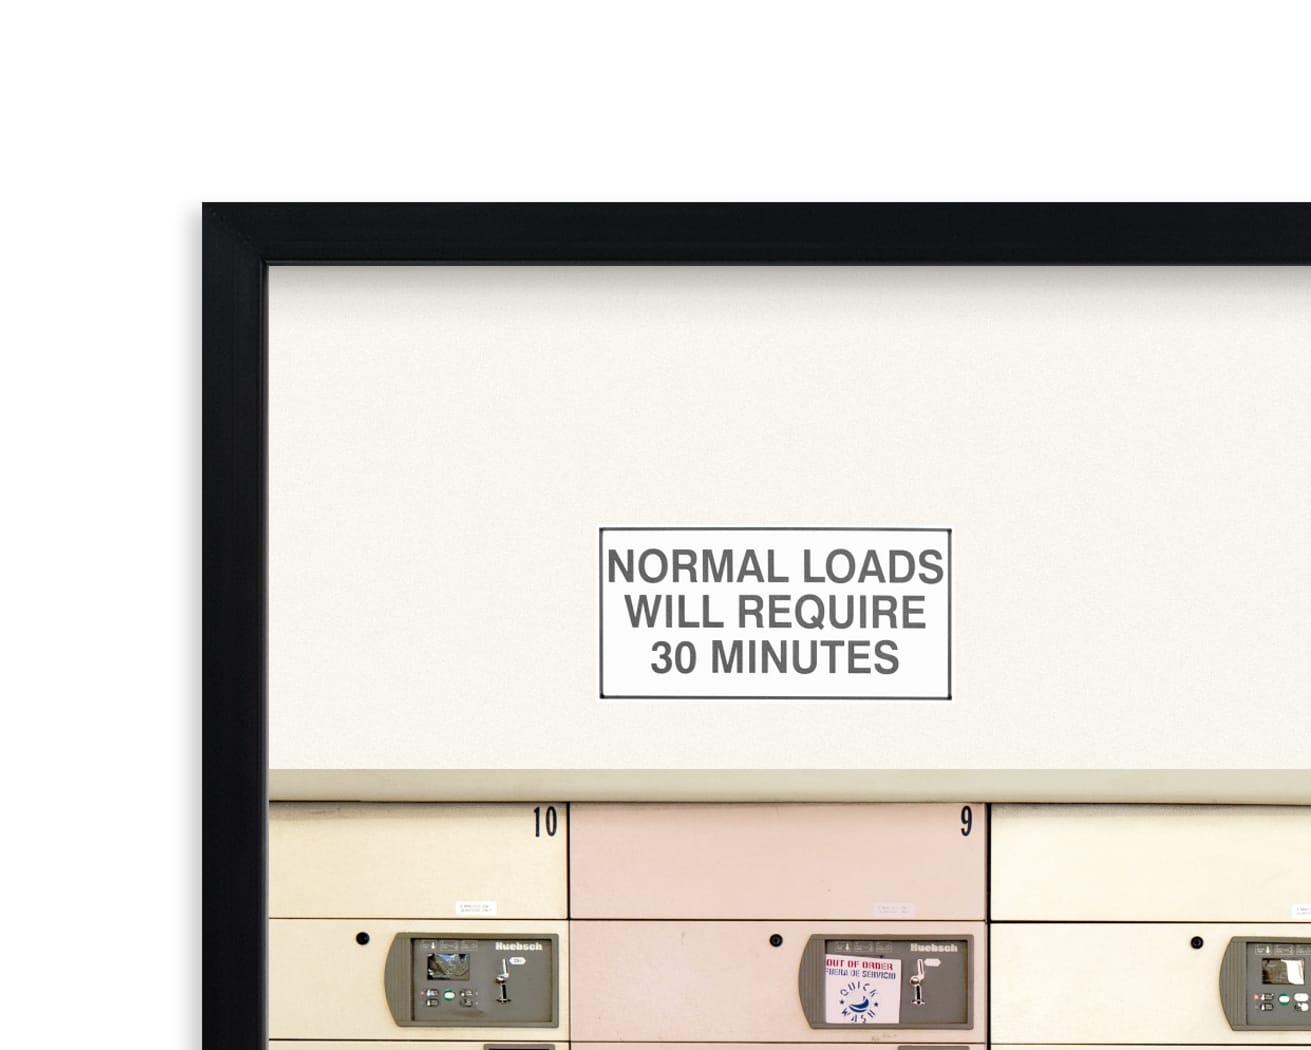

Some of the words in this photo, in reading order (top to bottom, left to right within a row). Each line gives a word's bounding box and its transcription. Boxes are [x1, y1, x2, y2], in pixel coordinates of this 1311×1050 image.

[607, 548, 790, 584] NORMAL
[803, 548, 945, 585] LOADS
[623, 594, 725, 629] WILL
[738, 593, 927, 630] REQUIRE
[650, 640, 698, 675] 30
[711, 639, 900, 675] MINUTES
[533, 805, 558, 838] 10
[960, 805, 974, 837] 9
[495, 941, 543, 952] Huebsch
[910, 943, 958, 953] Huebsch
[826, 958, 845, 968] OUT
[847, 959, 860, 969] OF
[862, 960, 894, 971] ORDER
[850, 968, 861, 978] DE
[839, 980, 880, 998] QUICK
[841, 1006, 877, 1024] WASH
